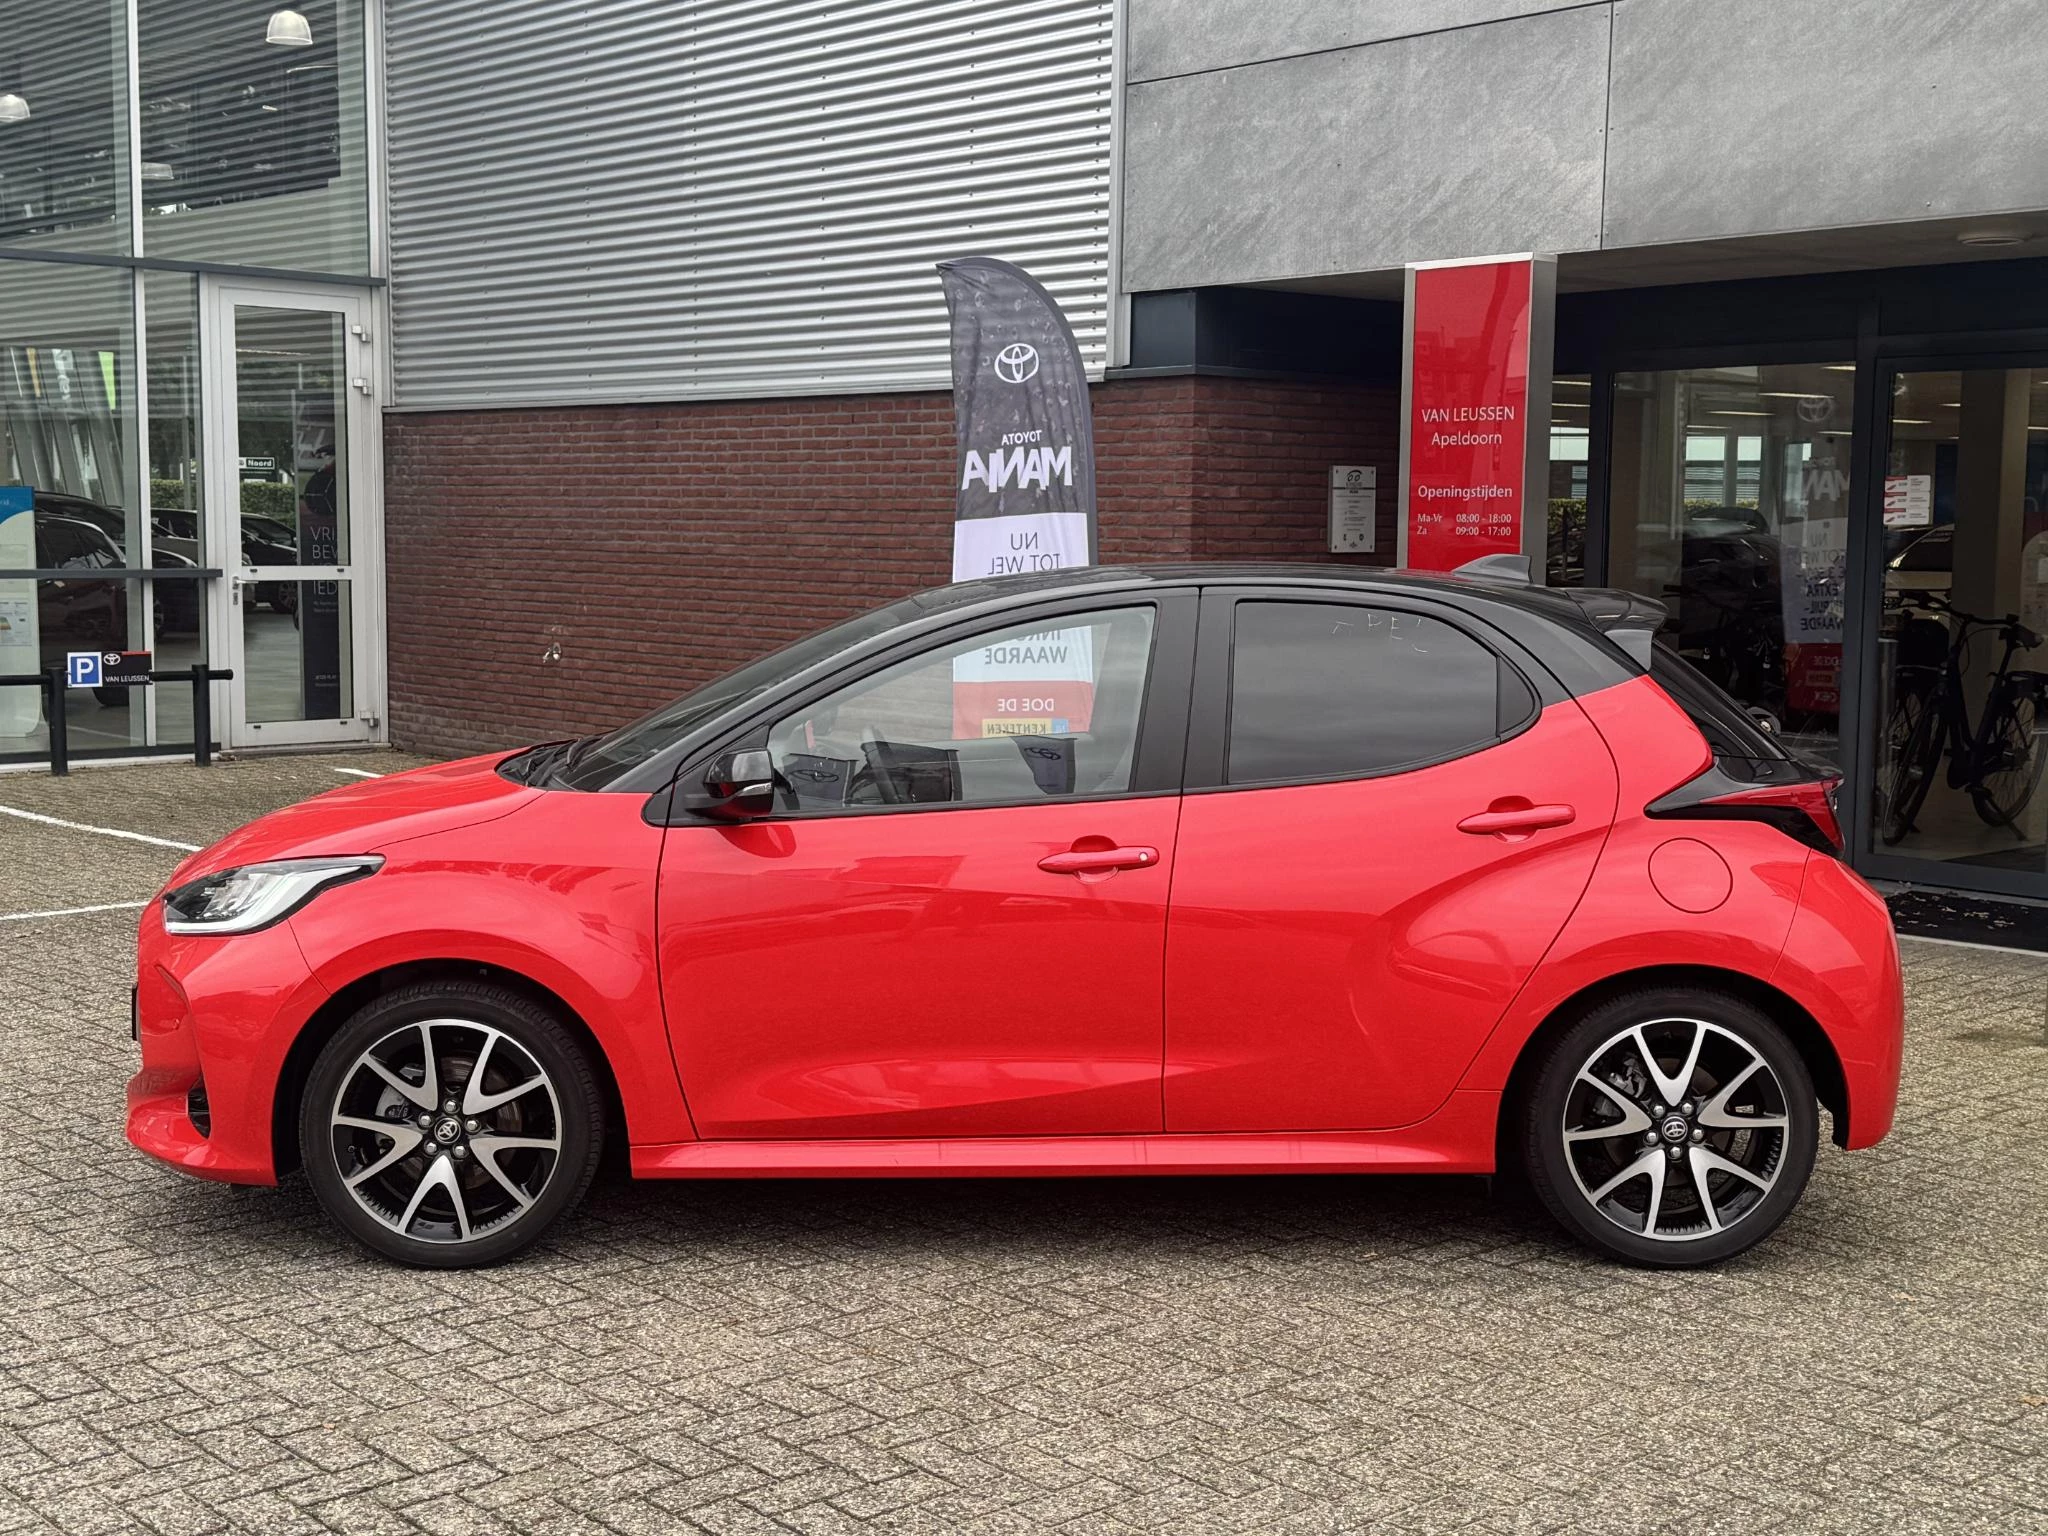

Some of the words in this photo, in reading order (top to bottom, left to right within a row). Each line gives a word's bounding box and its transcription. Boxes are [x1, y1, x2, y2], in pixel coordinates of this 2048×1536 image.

[1421, 408, 1450, 423] VAN
[1453, 406, 1515, 421] LEUSSEN
[1431, 430, 1502, 449] Apeldoorn
[247, 459, 272, 467] Noord
[1418, 485, 1513, 501] Openingstijden
[1417, 514, 1442, 523] Ma-Vr
[1456, 514, 1480, 523] 08:00
[1488, 514, 1512, 523] 18:00
[1417, 526, 1428, 535] Za
[1456, 527, 1480, 536] 09:00
[1488, 527, 1512, 536] 17:00
[76, 657, 94, 683] P
[120, 675, 150, 683] LEUSSEN
